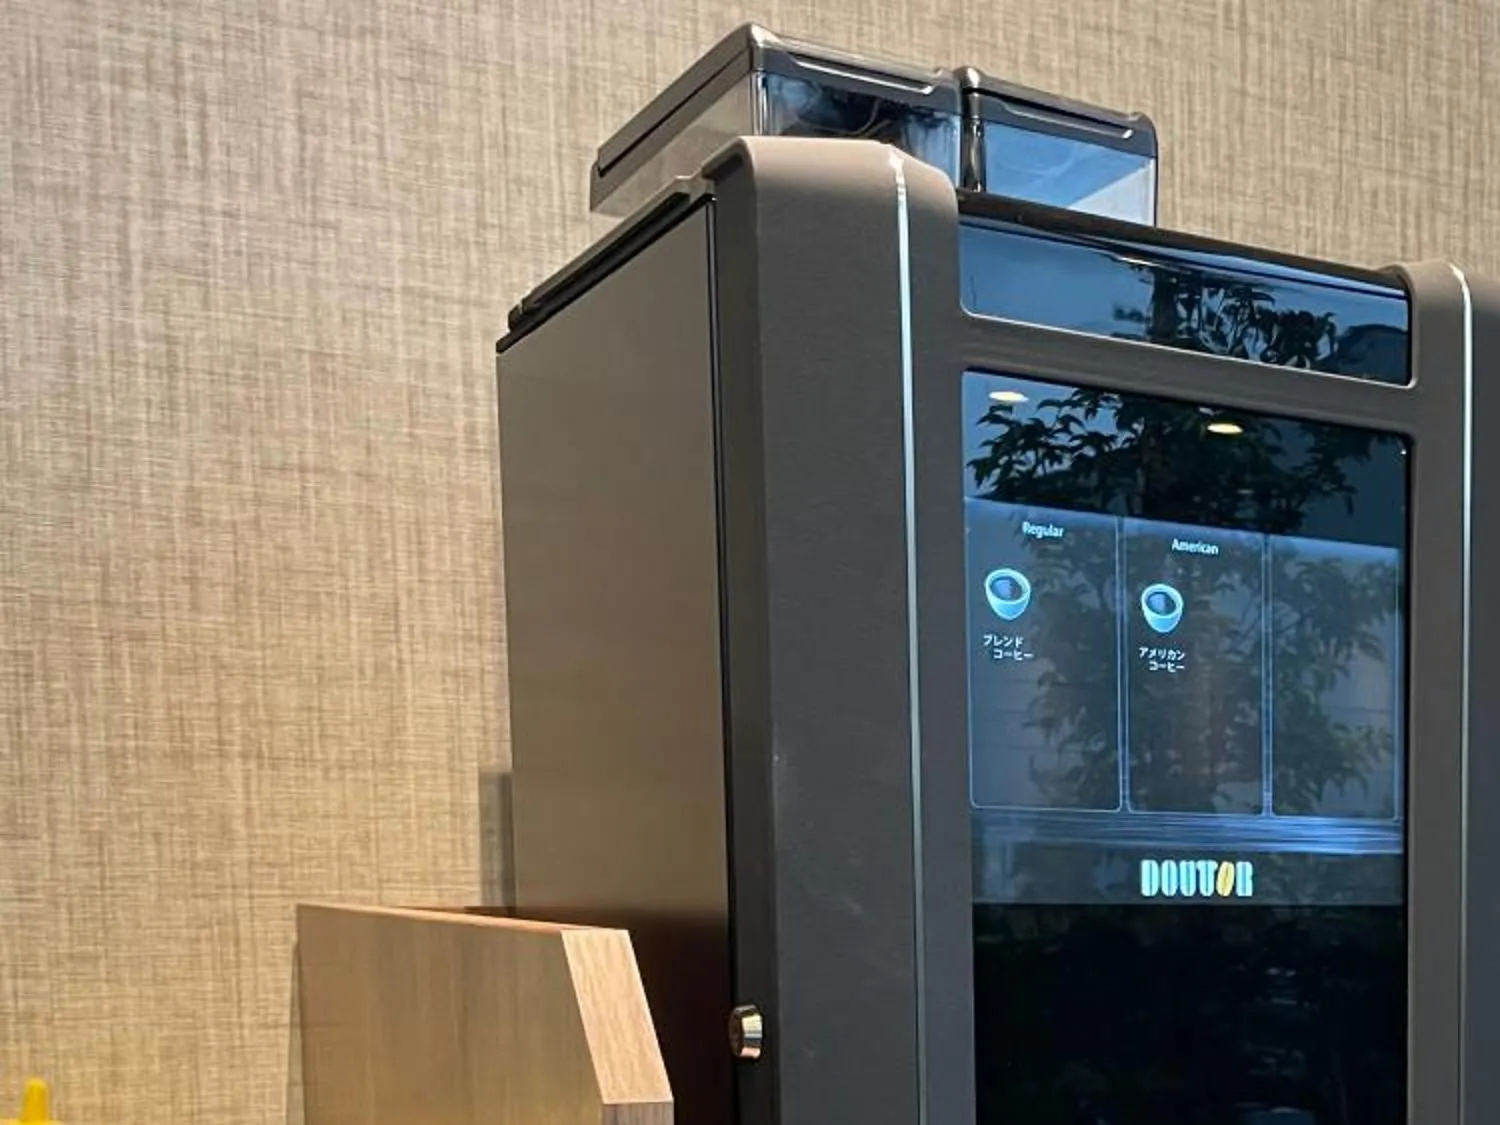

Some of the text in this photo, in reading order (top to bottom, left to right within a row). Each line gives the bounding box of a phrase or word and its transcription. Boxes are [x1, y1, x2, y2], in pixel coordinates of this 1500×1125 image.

[1022, 521, 1065, 539] Regular
[1171, 538, 1219, 555] American
[993, 649, 1034, 661] コーヒー
[1139, 647, 1185, 661] アメリカン
[1148, 660, 1185, 673] コーヒー
[1140, 859, 1253, 897] DOUTOR
